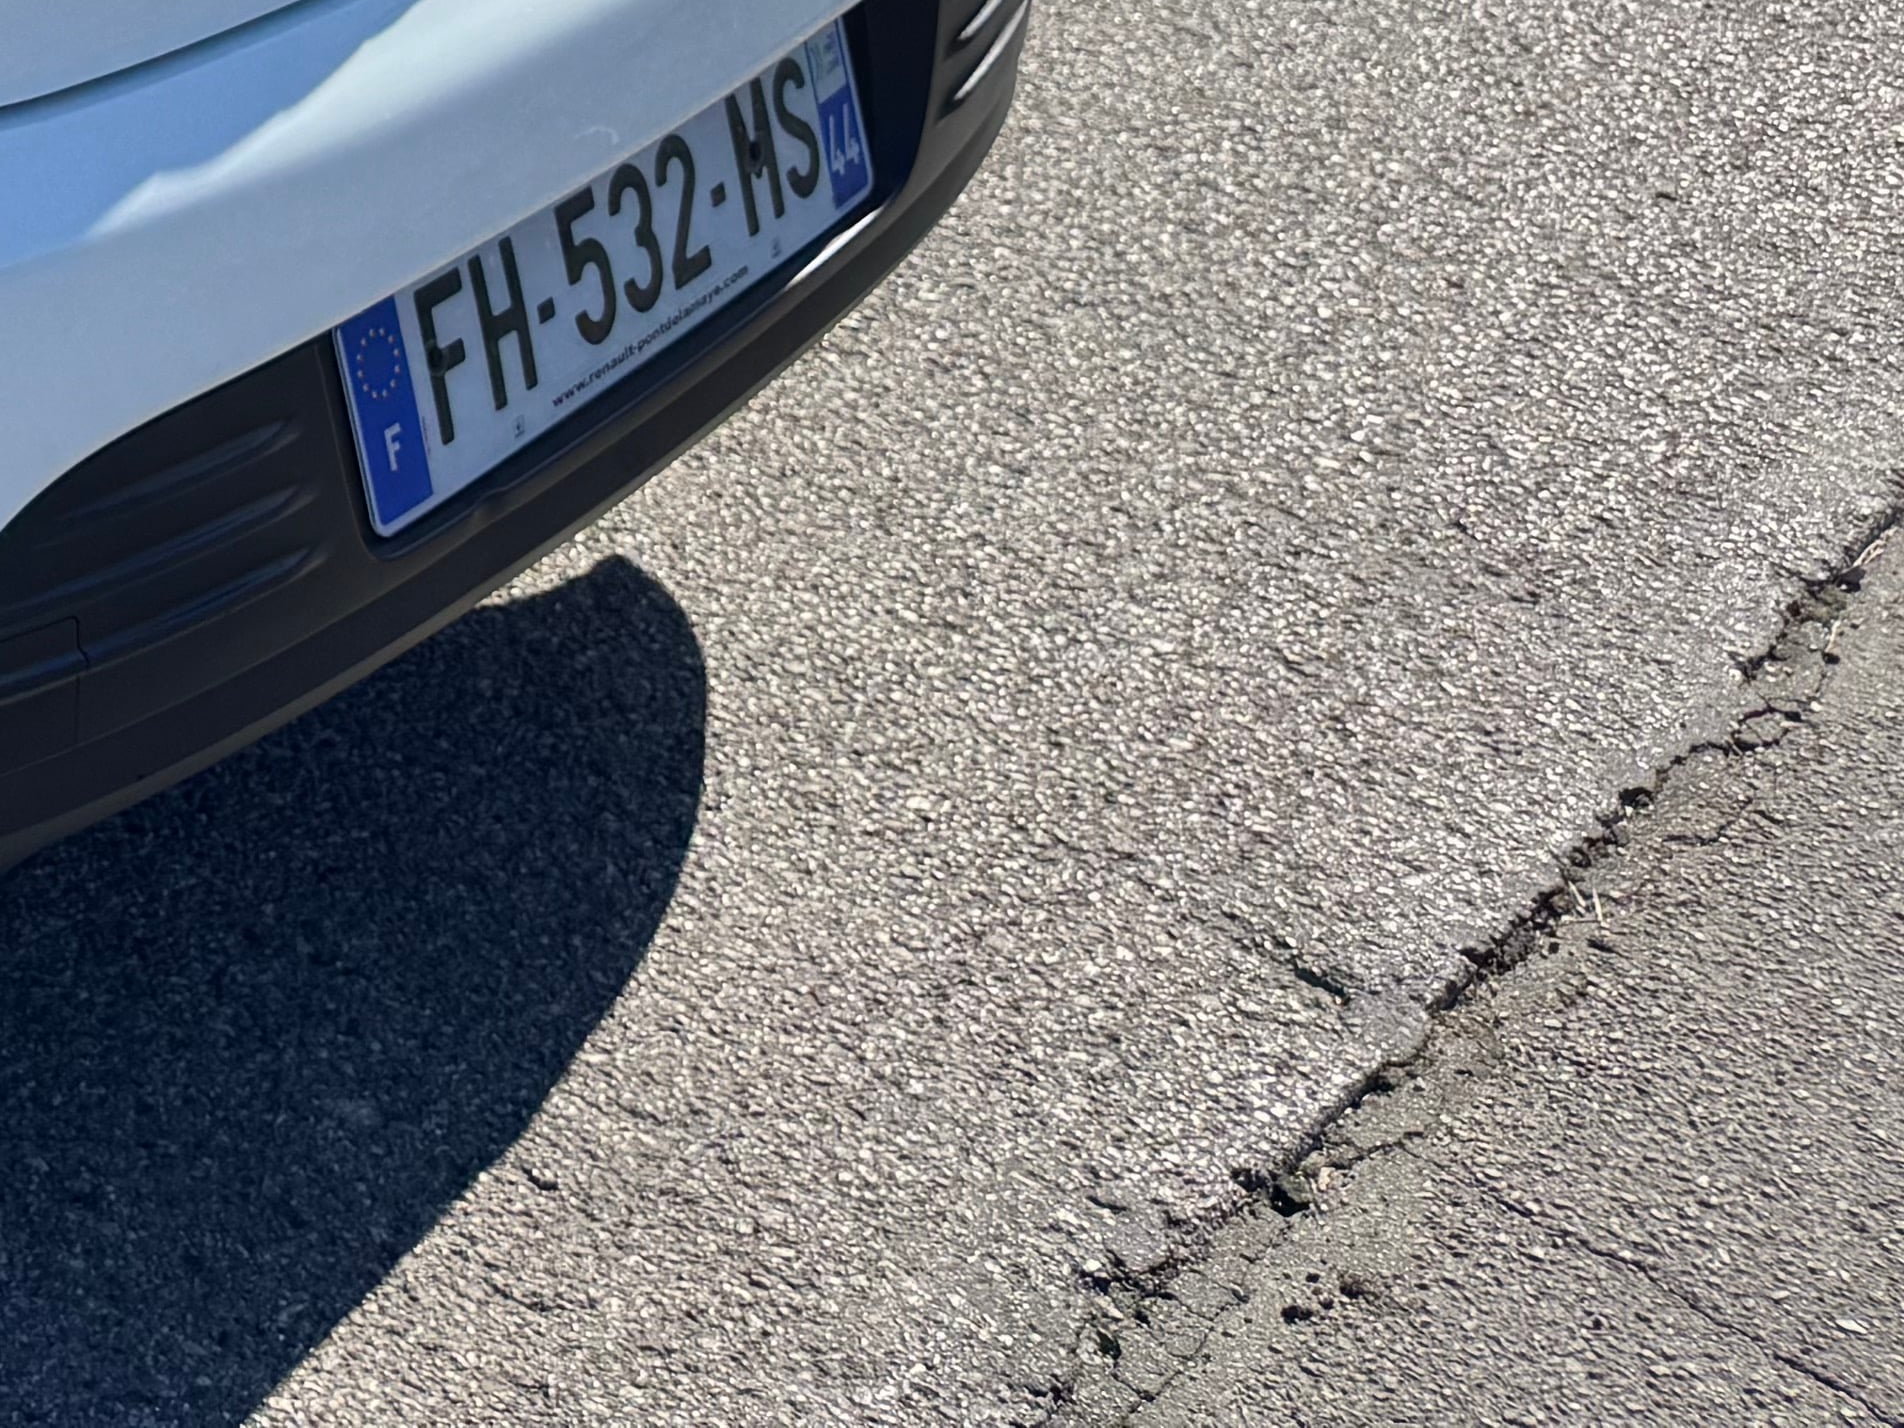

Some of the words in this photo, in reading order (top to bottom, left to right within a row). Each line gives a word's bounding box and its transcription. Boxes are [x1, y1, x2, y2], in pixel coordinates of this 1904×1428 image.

[828, 102, 861, 176] 44
[413, 56, 821, 446] FH-532-MS
[384, 421, 402, 472] F
